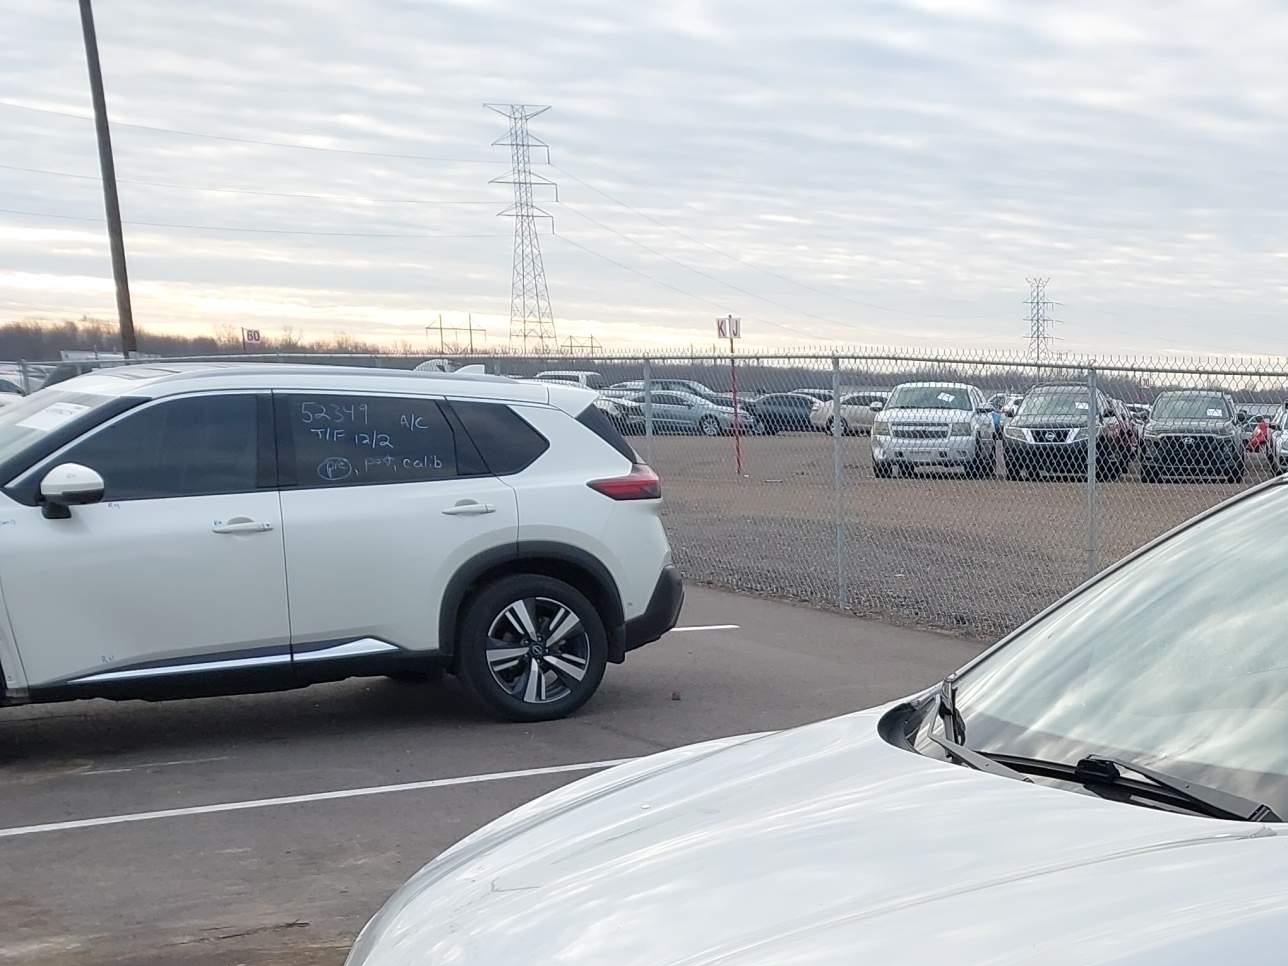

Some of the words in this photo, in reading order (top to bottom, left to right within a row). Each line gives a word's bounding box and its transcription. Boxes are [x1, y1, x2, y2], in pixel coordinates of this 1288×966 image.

[717, 319, 726, 337] K
[400, 413, 429, 432] A/C
[355, 430, 394, 449] 12/2
